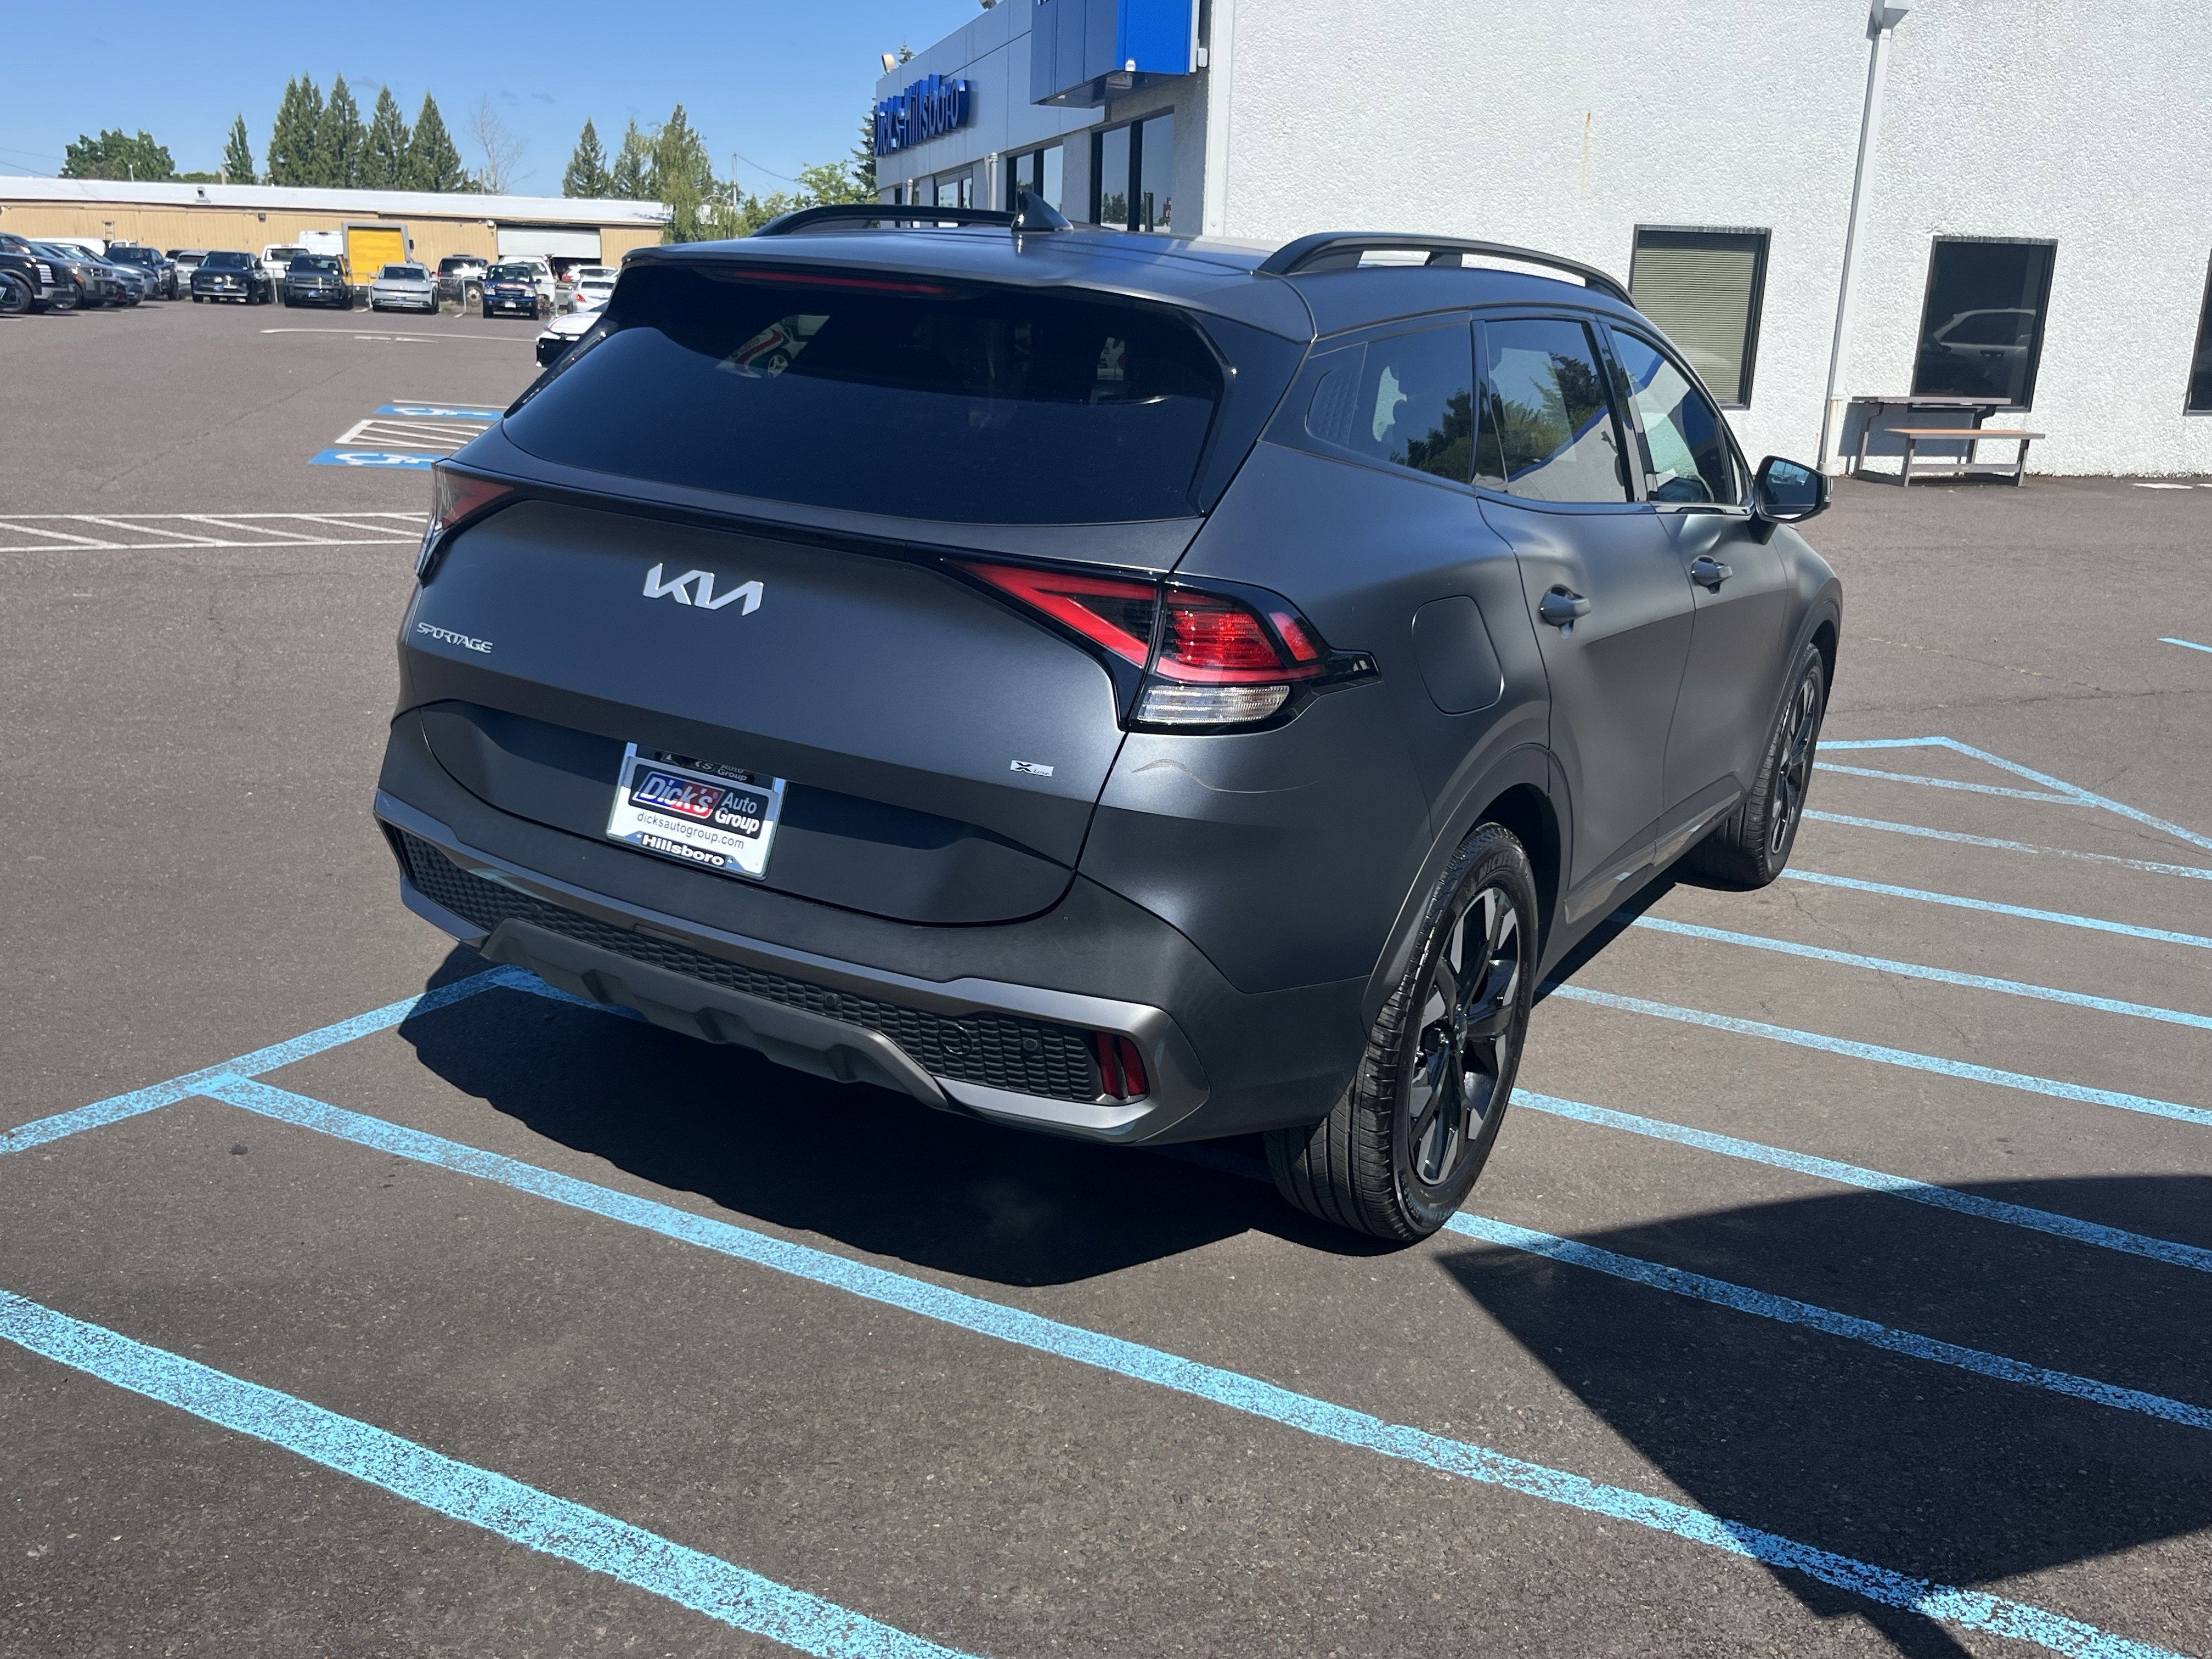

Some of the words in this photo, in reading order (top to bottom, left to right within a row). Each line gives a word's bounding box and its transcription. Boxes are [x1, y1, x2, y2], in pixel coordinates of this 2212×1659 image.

[642, 562, 764, 616] KIA
[417, 622, 493, 653] SPORTAGE
[718, 769, 747, 781] Group
[639, 777, 714, 812] Dick's
[720, 792, 758, 815] Auto
[637, 811, 745, 849] dicksautogroup.com
[715, 807, 760, 834] Group
[642, 834, 725, 866] Hillsboro
